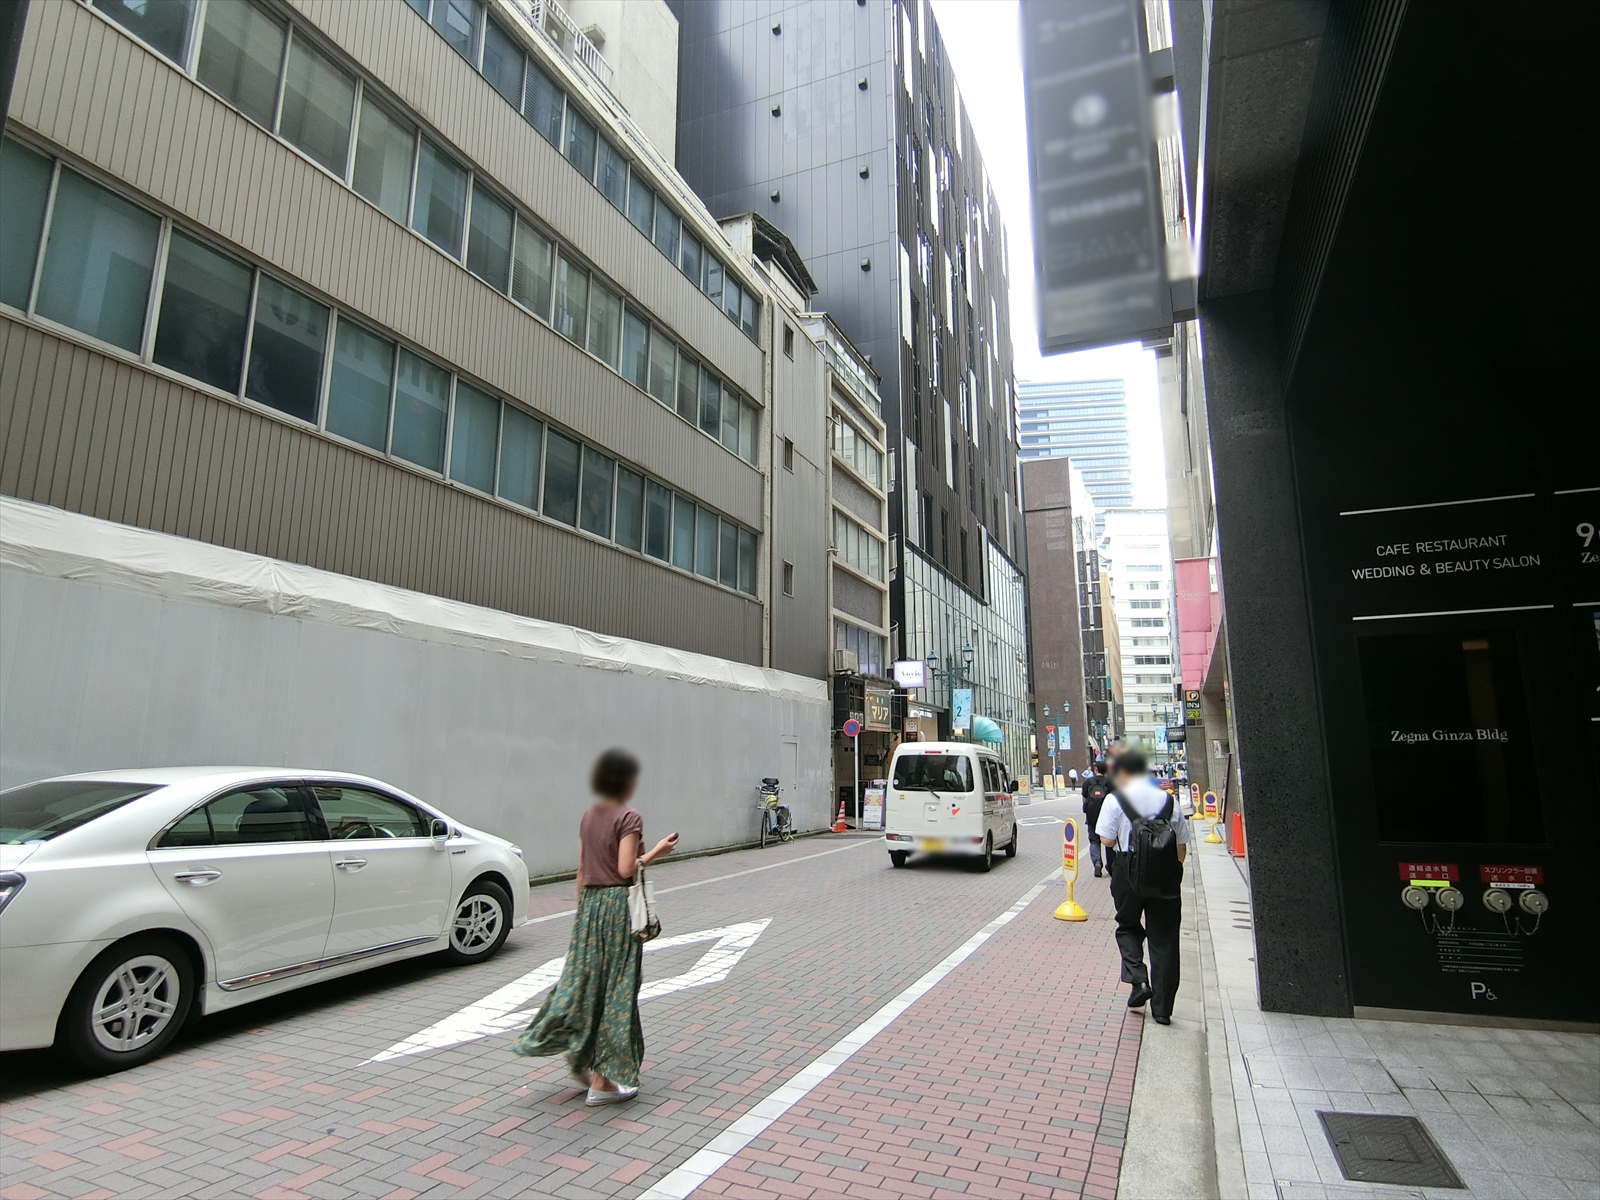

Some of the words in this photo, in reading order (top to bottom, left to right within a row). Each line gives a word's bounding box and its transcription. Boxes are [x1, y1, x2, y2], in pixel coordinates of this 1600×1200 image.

[1376, 544, 1411, 557] CAFE
[1415, 534, 1507, 553] RESTAURANT
[1351, 564, 1415, 580] WEDDING
[1419, 563, 1431, 575] &
[1435, 558, 1490, 574] BEAUTY
[1493, 554, 1541, 568] SALON
[871, 705, 889, 721] マリア
[957, 705, 963, 717] 2
[1391, 730, 1429, 744] Zegna
[1433, 730, 1473, 741] Ginza
[1476, 729, 1509, 742] Bldg
[1484, 867, 1538, 875] スプリンクラー設備
[1470, 981, 1486, 1000] P
